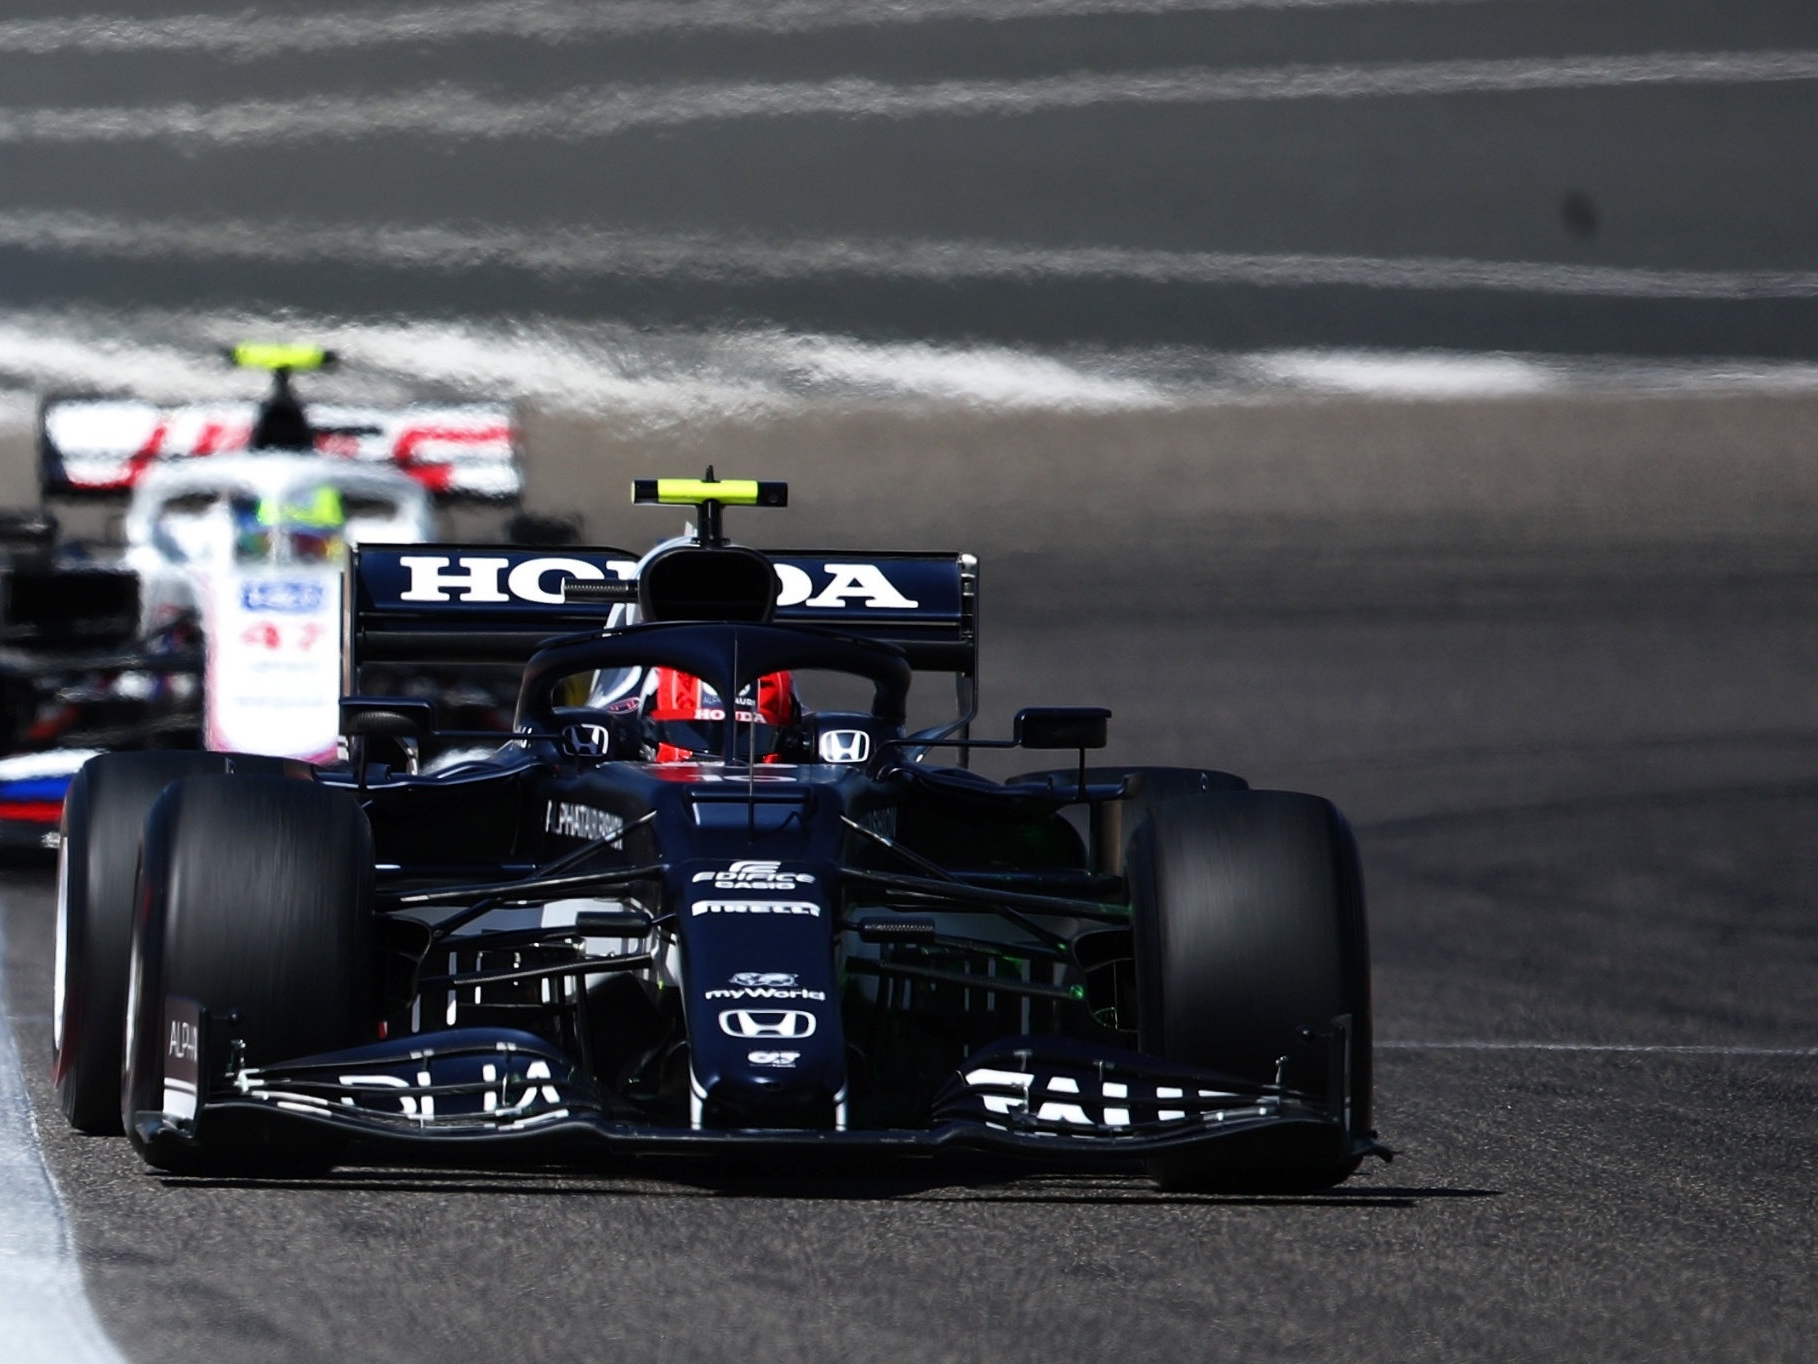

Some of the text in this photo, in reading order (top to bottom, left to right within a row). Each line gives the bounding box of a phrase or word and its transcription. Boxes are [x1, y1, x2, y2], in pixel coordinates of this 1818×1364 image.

[399, 556, 919, 609] HOA
[240, 618, 327, 652] 47
[691, 871, 816, 884] EDIFICE
[714, 881, 796, 890] CASIO
[691, 900, 820, 917] PIRELLI
[705, 988, 825, 1001] myWorld
